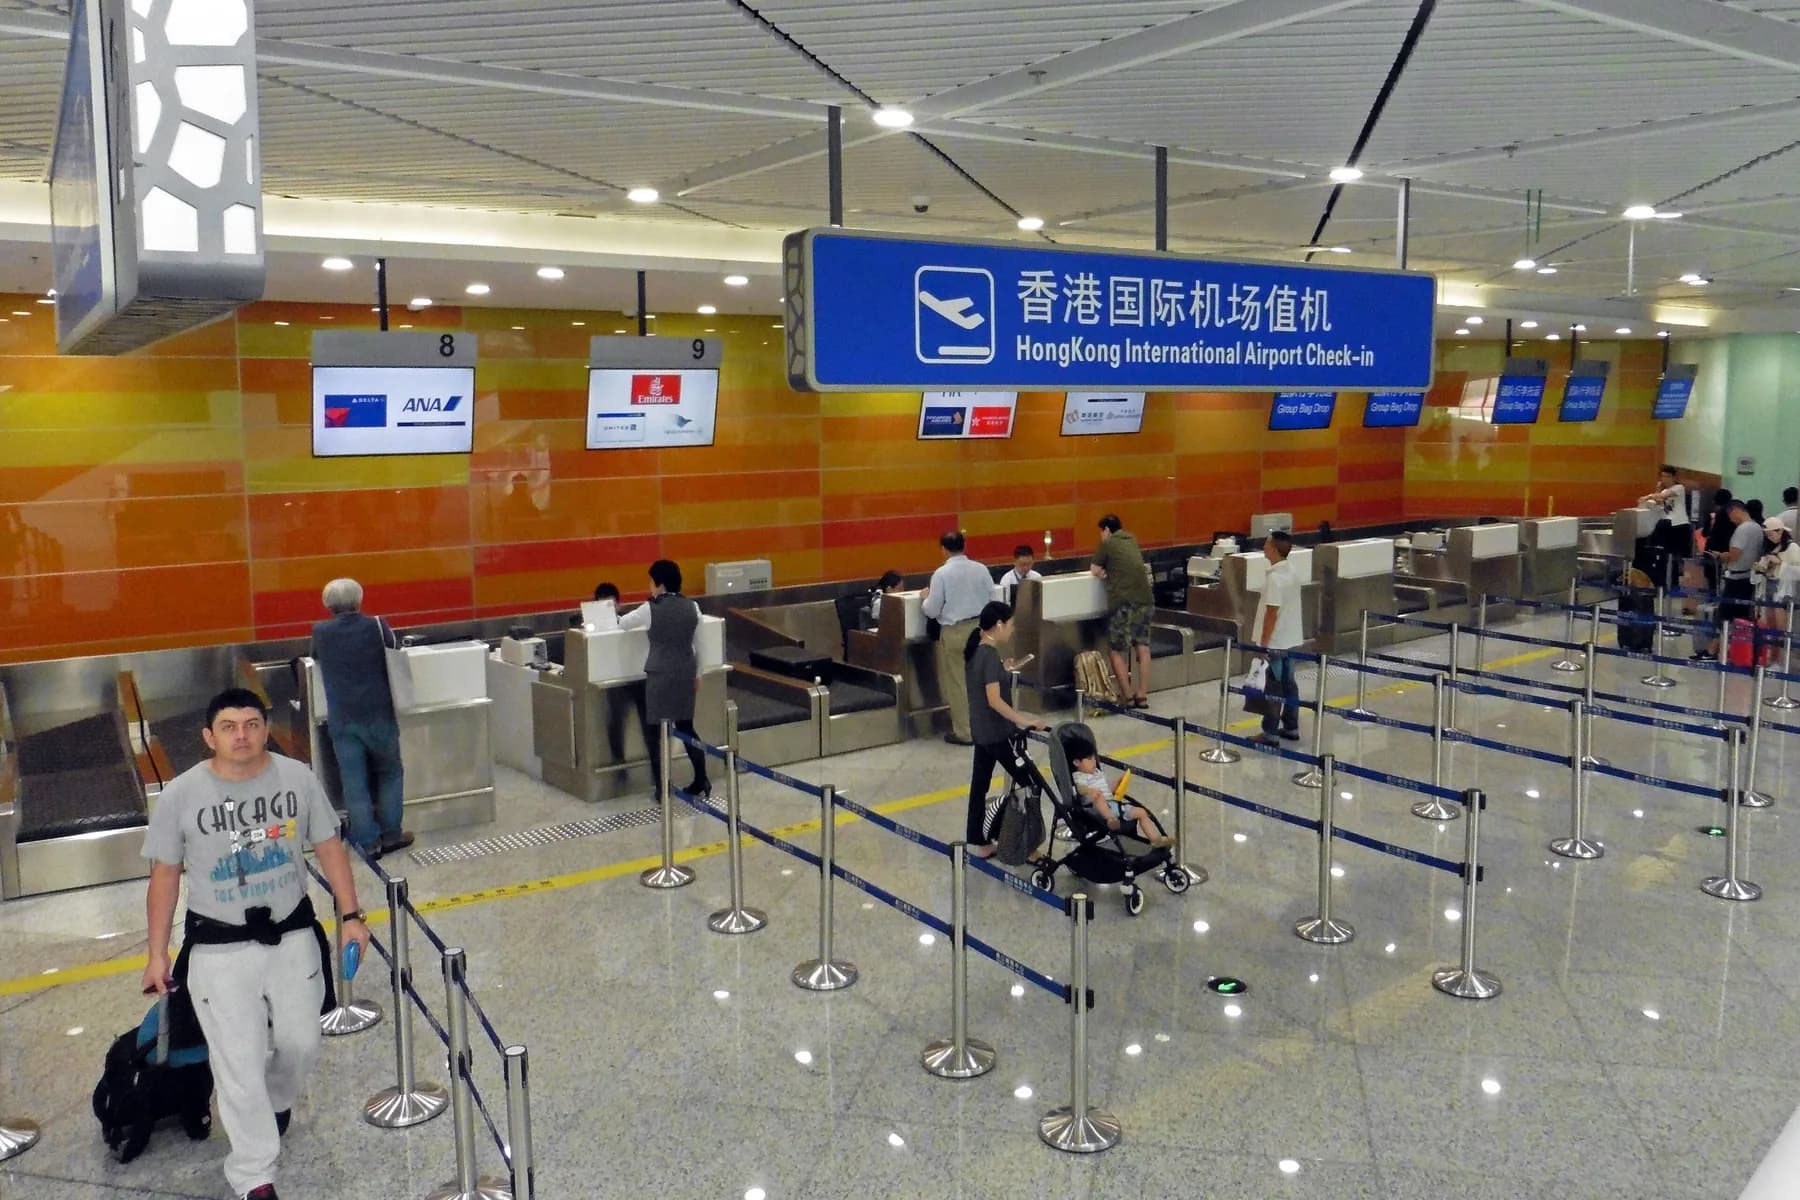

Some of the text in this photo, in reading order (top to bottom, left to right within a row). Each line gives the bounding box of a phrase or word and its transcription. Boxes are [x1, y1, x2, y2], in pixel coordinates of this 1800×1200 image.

[1016, 270, 1332, 333] 香港国际机场值机
[439, 334, 455, 357] 8
[691, 339, 706, 360] 9
[1125, 339, 1241, 365] International
[1244, 345, 1303, 370] Airport
[1305, 347, 1374, 368] Check-in
[402, 397, 443, 412] ANA
[638, 395, 674, 404] Emirates
[1277, 403, 1330, 415] Group Bag Drop
[1370, 402, 1418, 414] Group Bag Drop
[197, 791, 298, 835] CHICAGO
